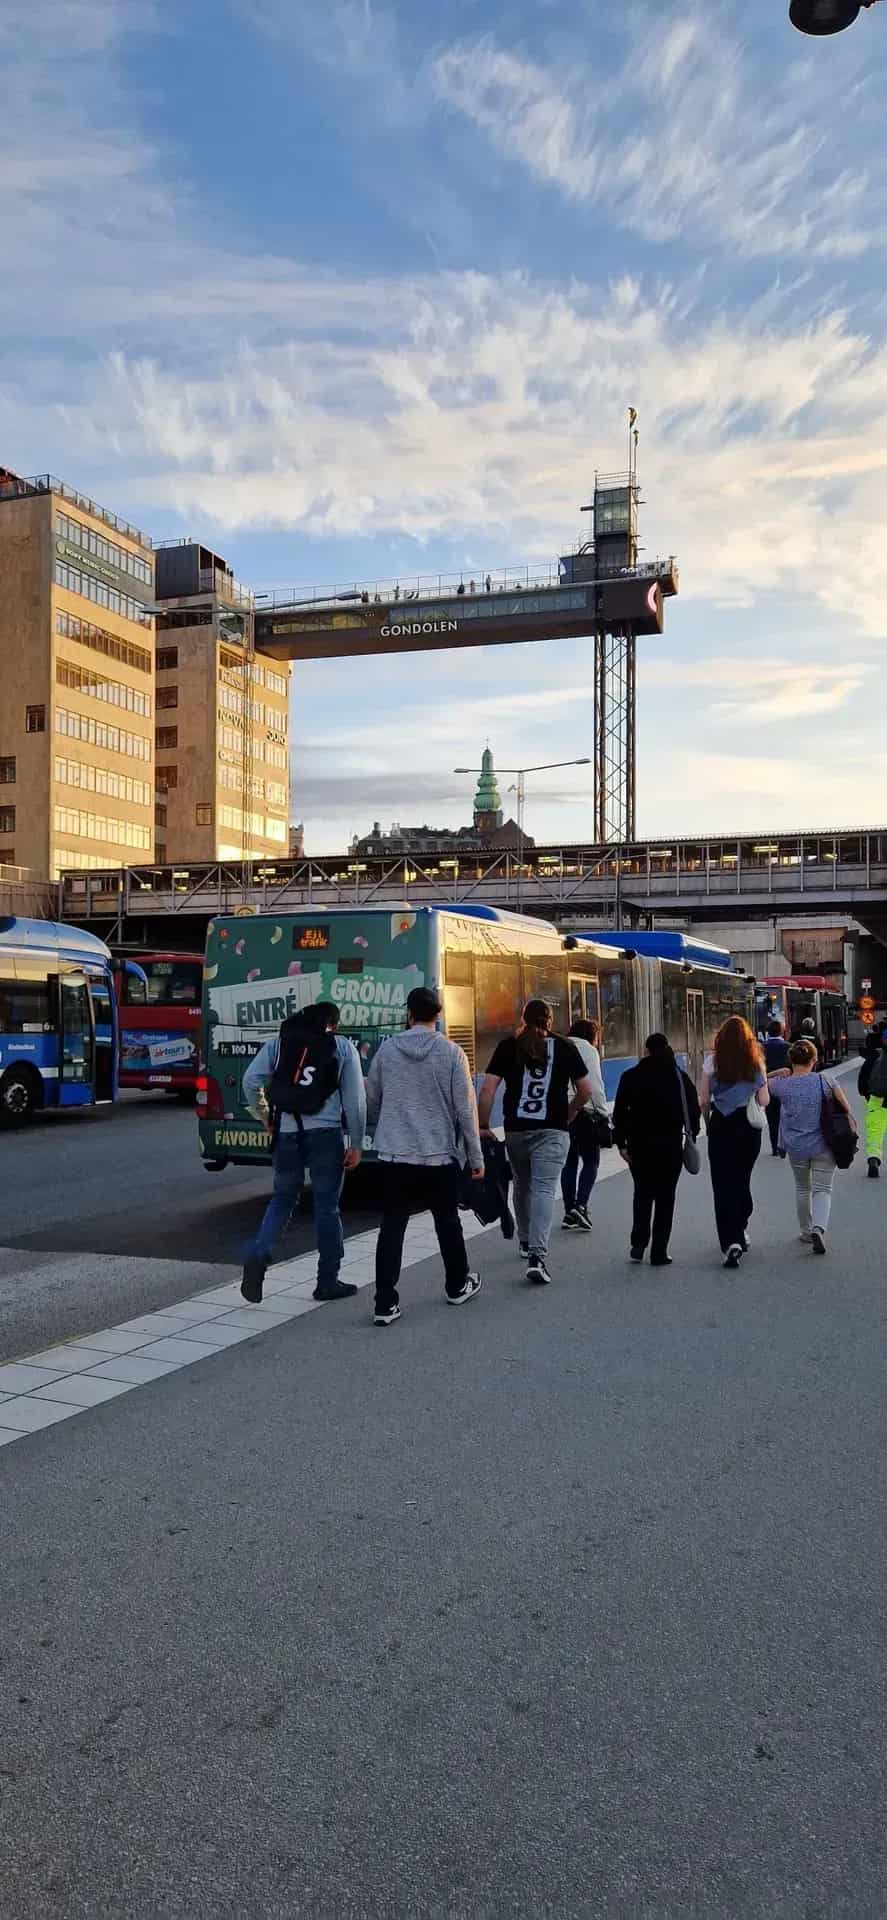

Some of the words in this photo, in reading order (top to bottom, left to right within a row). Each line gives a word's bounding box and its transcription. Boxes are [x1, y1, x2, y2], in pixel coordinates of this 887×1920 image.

[380, 620, 458, 637] GONDOLEN
[330, 975, 406, 1006] GRÖNA
[236, 987, 297, 1025] ENTRÉ
[231, 1044, 247, 1055] 100
[248, 1044, 257, 1055] kr
